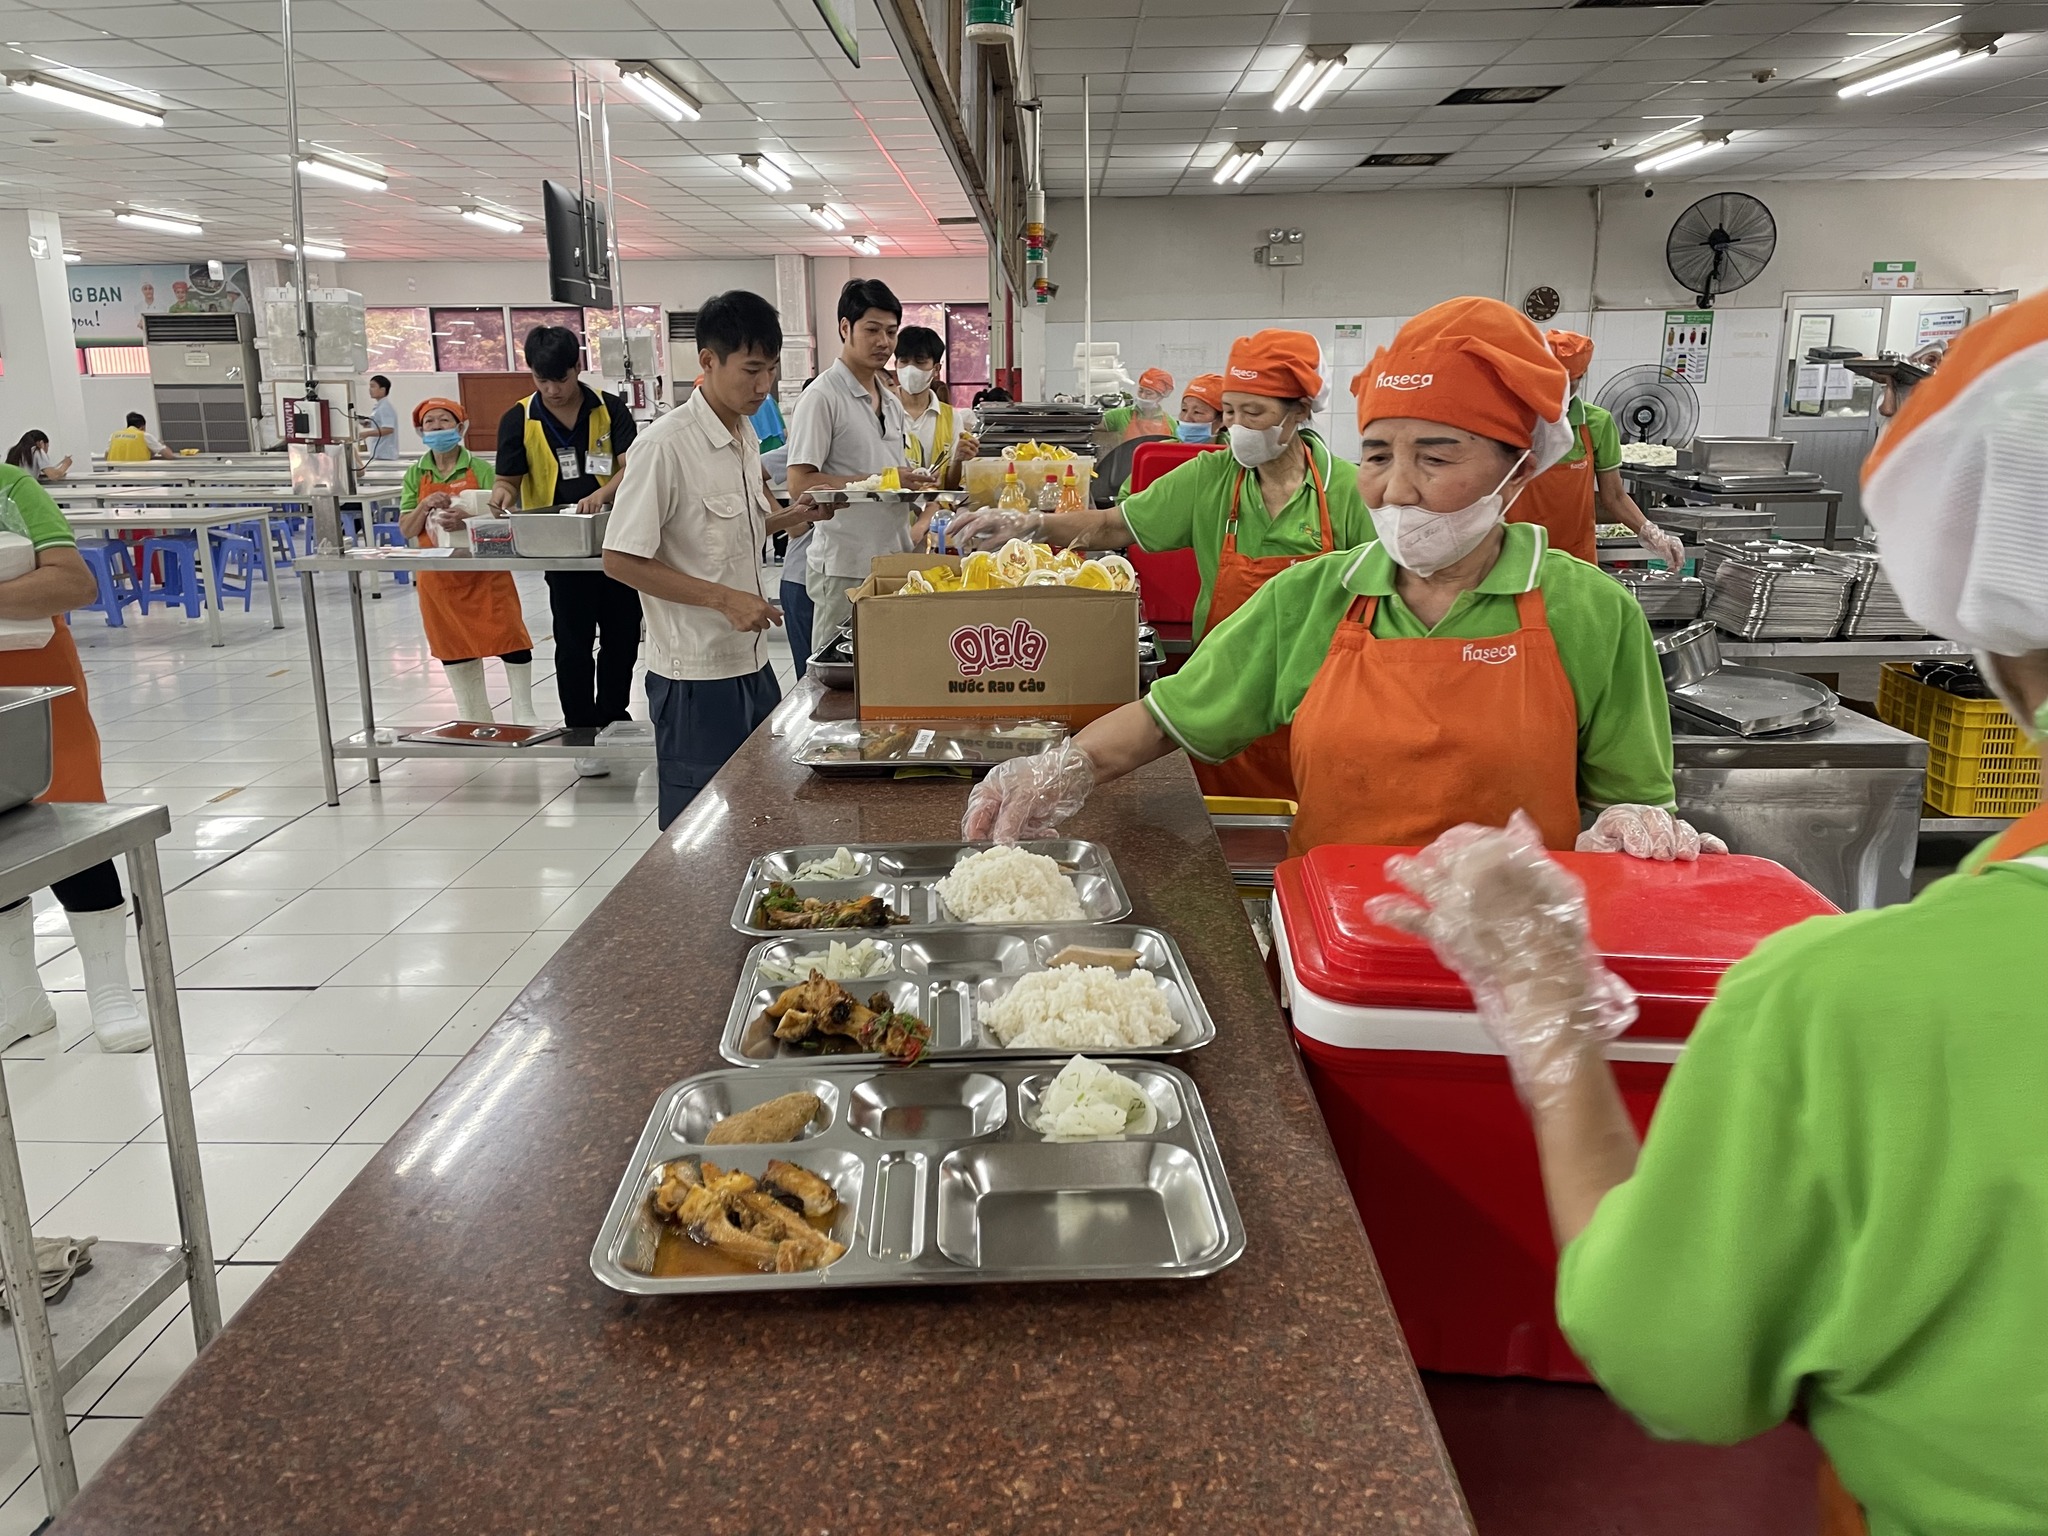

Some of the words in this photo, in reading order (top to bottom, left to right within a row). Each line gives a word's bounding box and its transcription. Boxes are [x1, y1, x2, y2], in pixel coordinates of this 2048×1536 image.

[88, 286, 122, 306] BẠN
[1375, 371, 1434, 391] haseca
[1462, 643, 1518, 665] haseca
